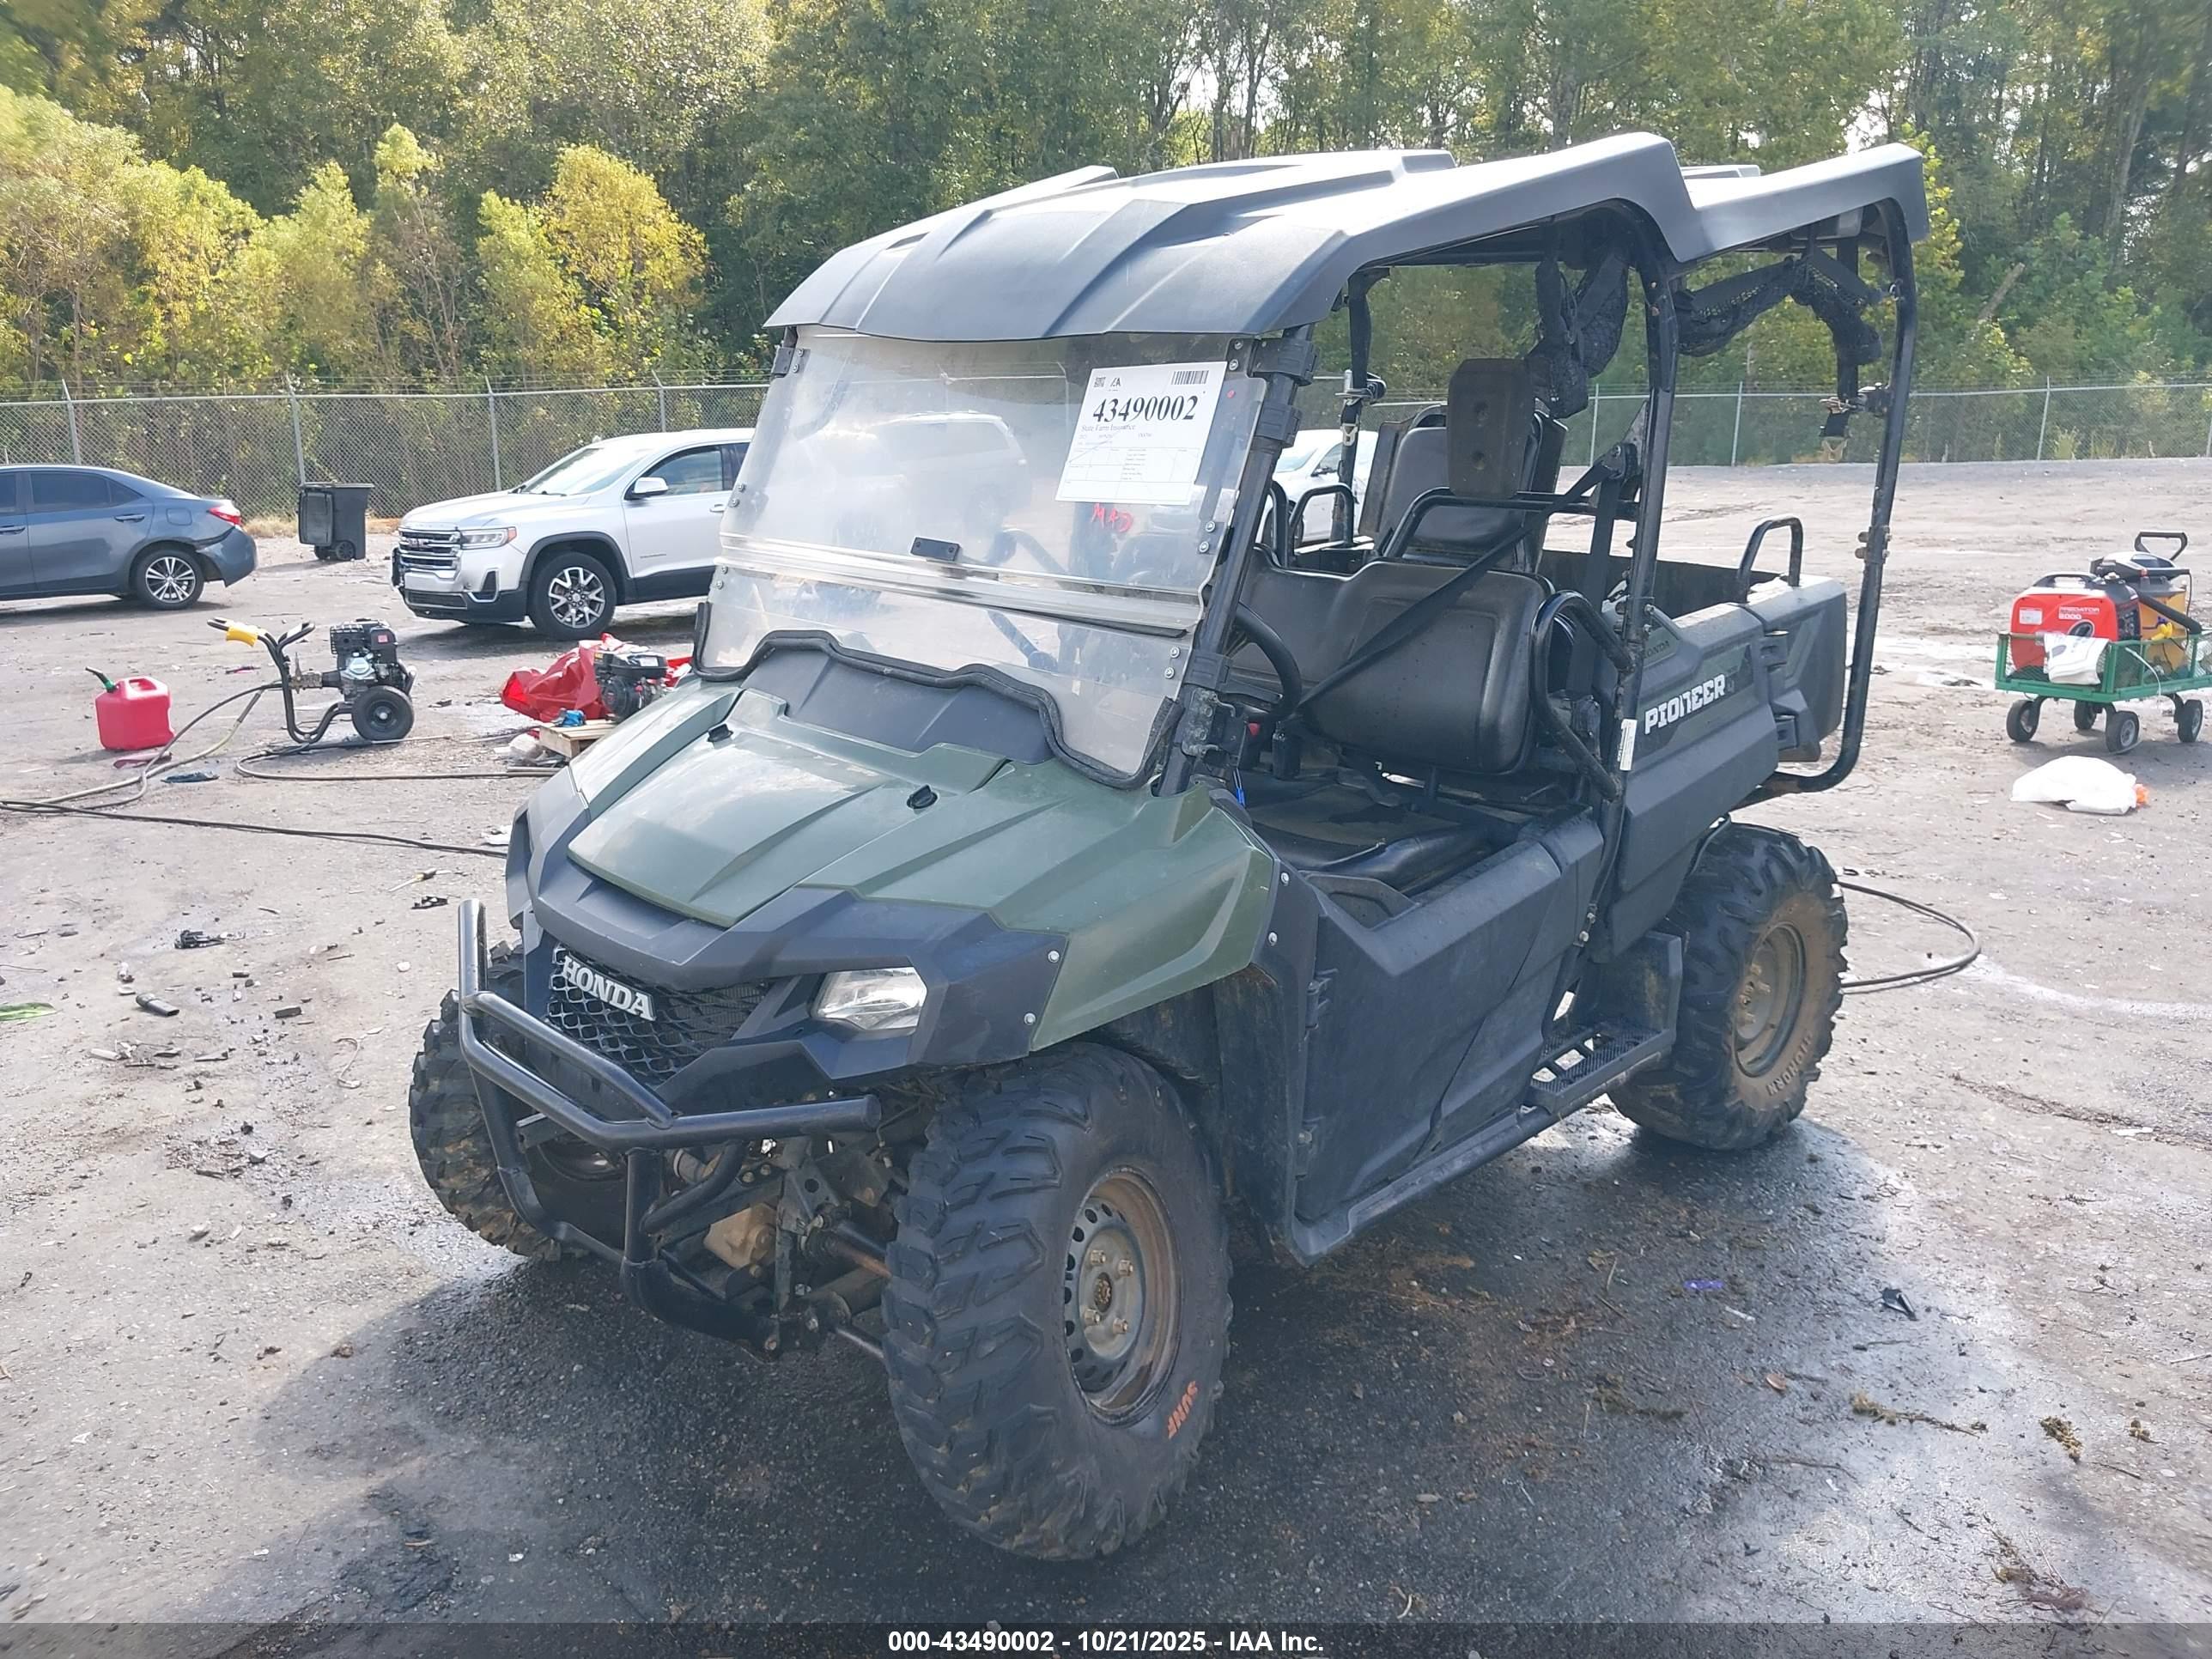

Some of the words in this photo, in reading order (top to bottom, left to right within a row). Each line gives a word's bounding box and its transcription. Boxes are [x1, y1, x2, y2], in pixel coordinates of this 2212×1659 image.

[1092, 395, 1199, 422] 43490002
[1644, 673, 1726, 735] PIONEER
[562, 955, 656, 1022] HONDA
